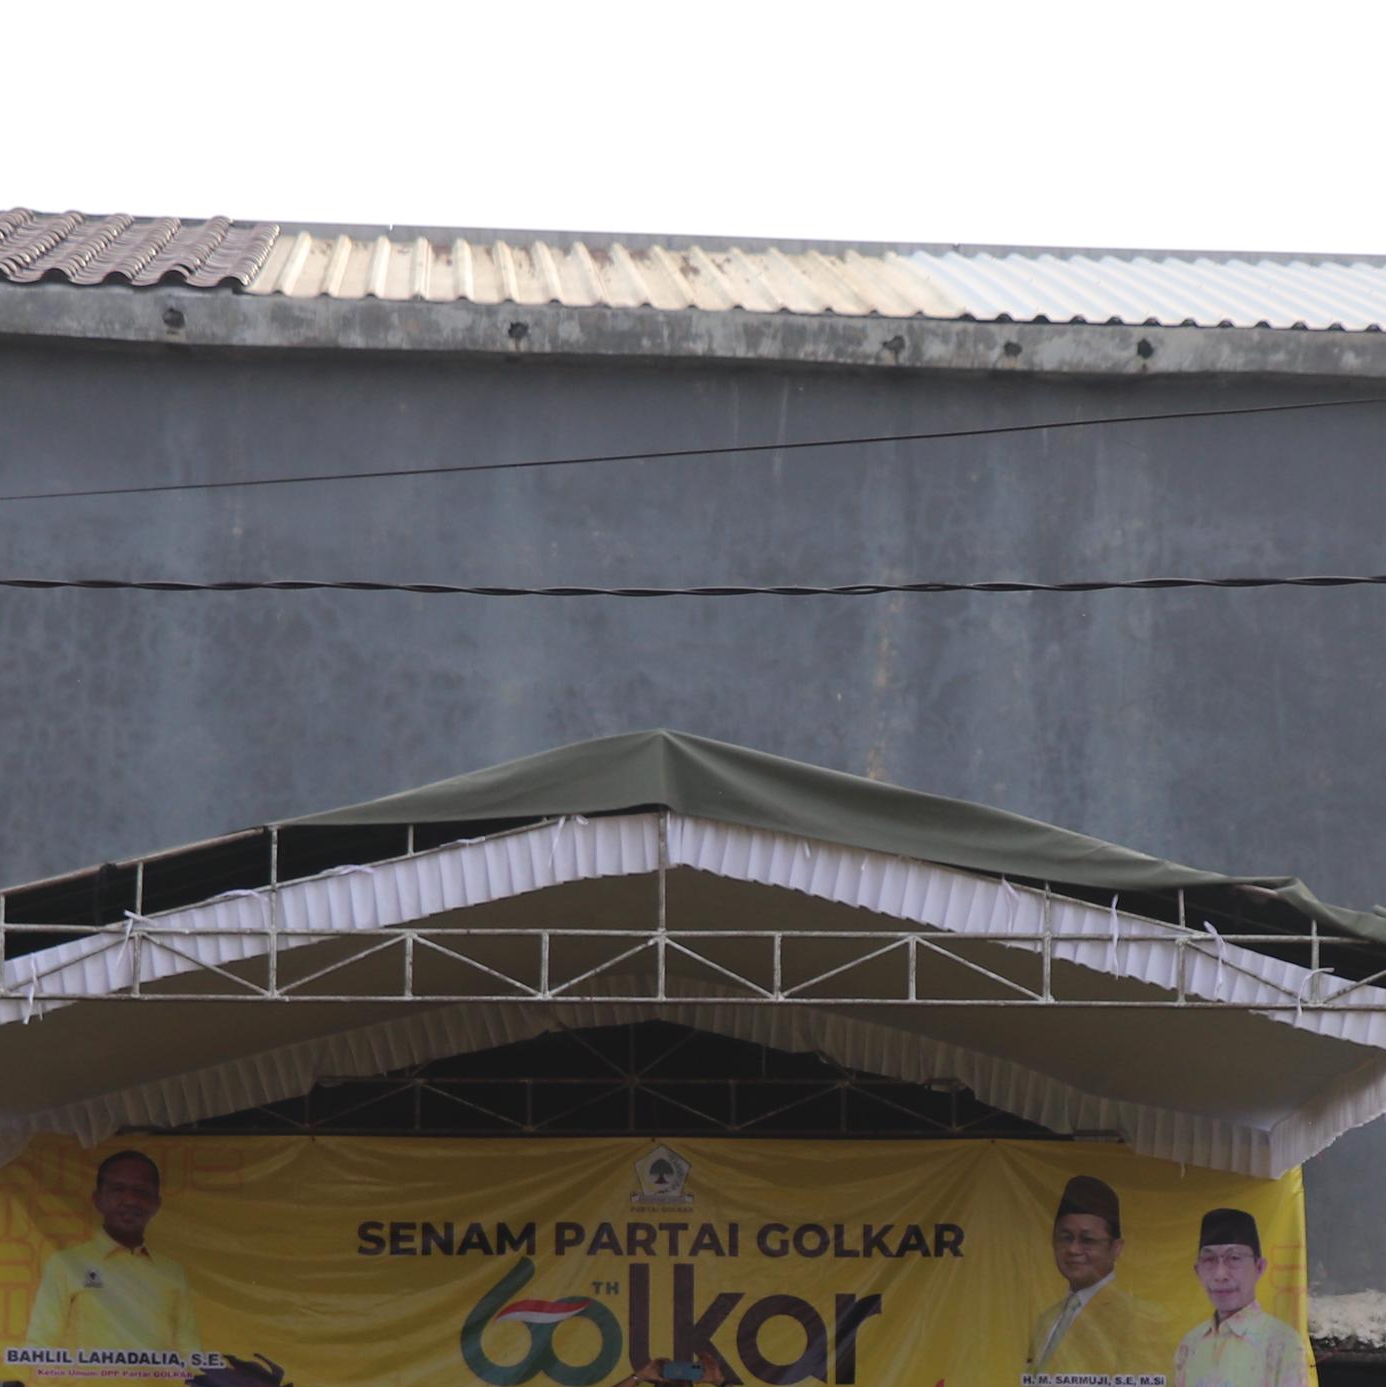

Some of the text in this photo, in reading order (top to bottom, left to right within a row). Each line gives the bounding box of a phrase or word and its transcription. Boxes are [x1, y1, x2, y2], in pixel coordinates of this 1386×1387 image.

[357, 1221, 965, 1259] SENAM PARTAI GOLKAR
[6, 1349, 225, 1367] BAHLIL LAHADALIA, S.E.
[1055, 1375, 1111, 1387] SARMUJI,
